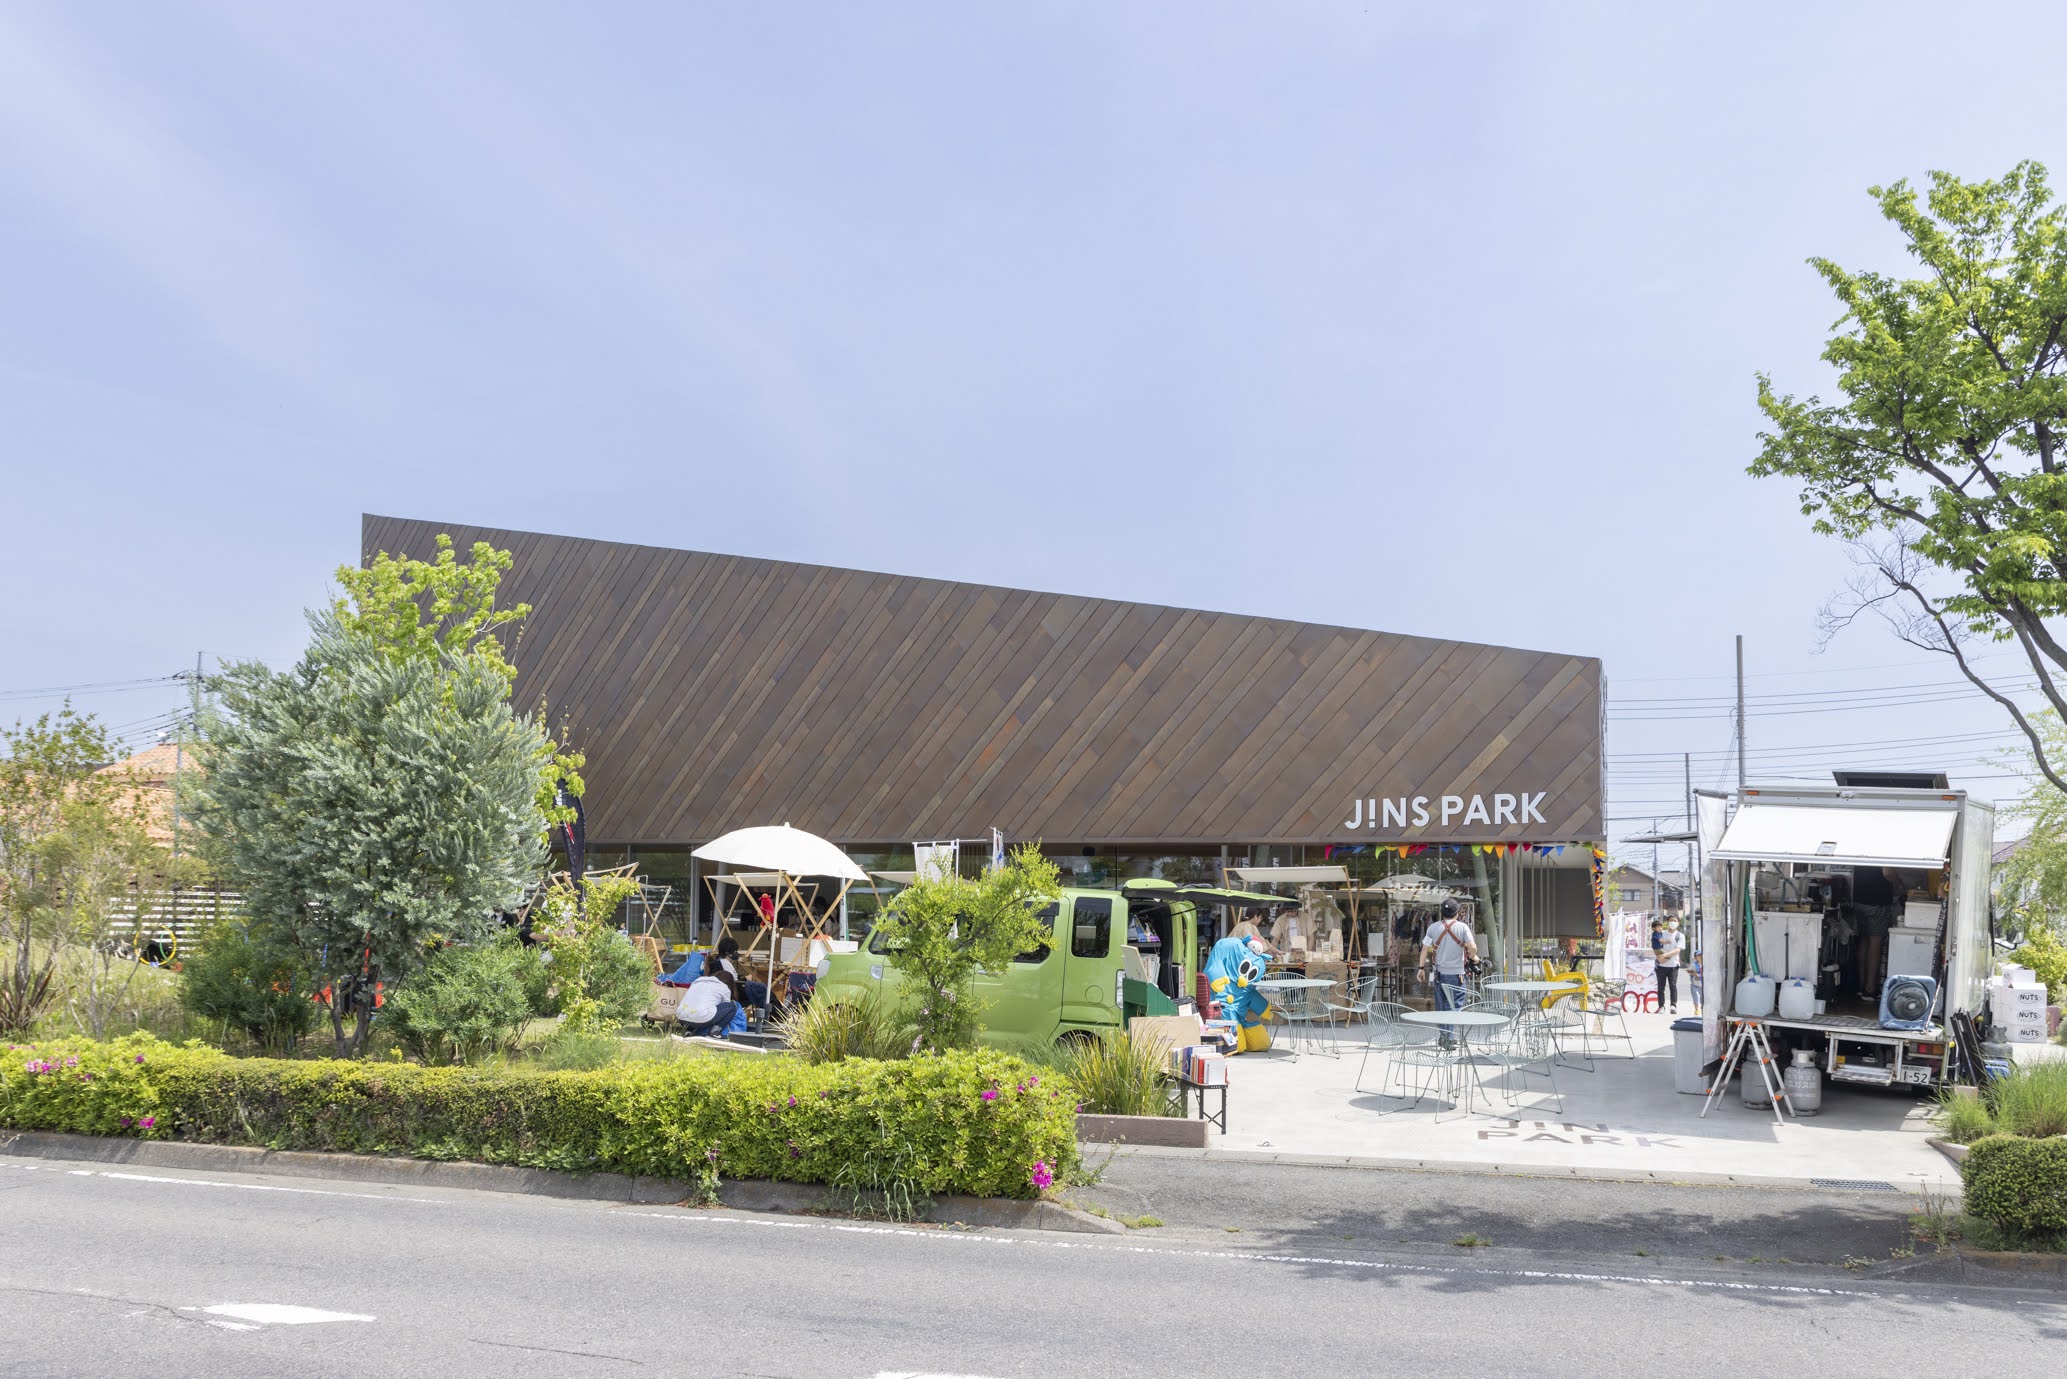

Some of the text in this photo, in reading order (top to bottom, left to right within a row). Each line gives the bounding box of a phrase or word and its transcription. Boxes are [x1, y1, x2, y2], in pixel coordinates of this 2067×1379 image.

[1441, 791, 1548, 826] PARK
[660, 998, 676, 1006] GU
[2020, 1029, 2040, 1037] NUTS
[1903, 1070, 1928, 1084] 1-52
[1477, 1130, 1685, 1148] PARK
